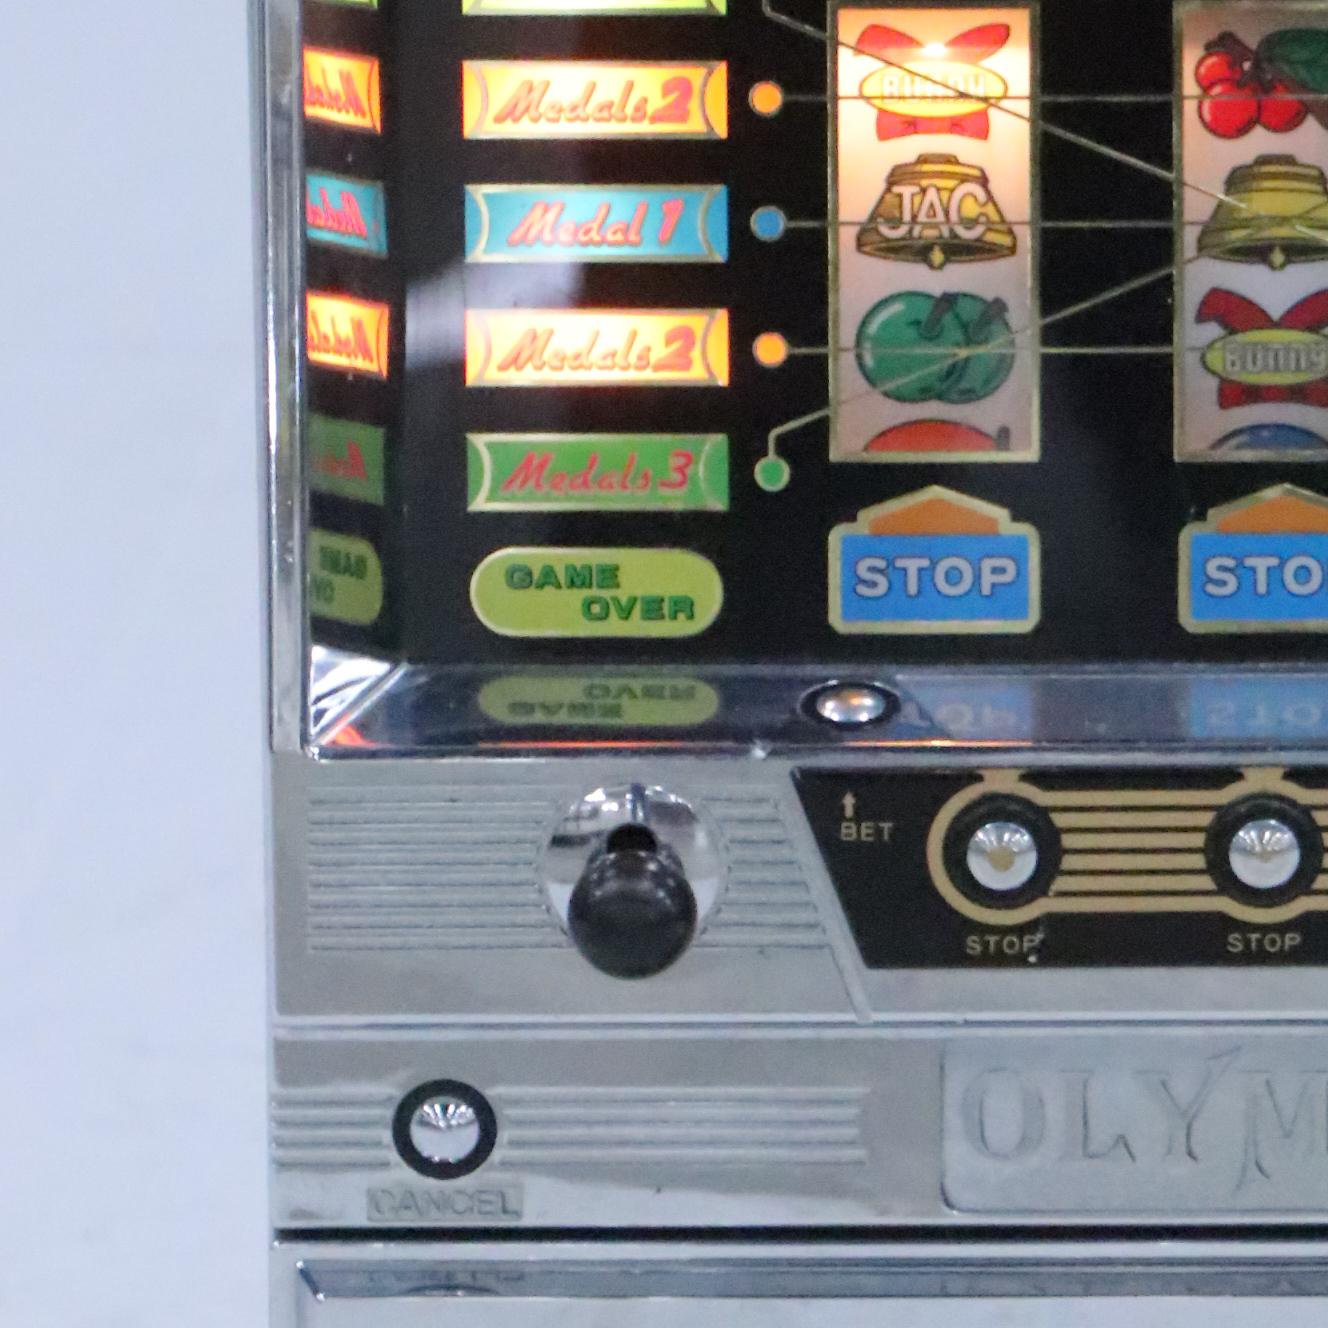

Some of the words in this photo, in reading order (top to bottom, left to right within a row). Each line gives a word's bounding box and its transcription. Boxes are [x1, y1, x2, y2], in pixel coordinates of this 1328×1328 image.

[492, 79, 649, 125] Medals
[648, 76, 695, 125] 2
[507, 201, 649, 246] Medal
[657, 198, 685, 245] 1
[876, 181, 992, 240] JAC
[496, 327, 652, 373] Medals
[650, 324, 697, 372] 2
[500, 451, 651, 495] Medals
[659, 450, 694, 492] 3
[504, 563, 621, 590] GAME
[853, 555, 1019, 599] STOP
[581, 595, 695, 621] OVER
[840, 822, 894, 842] BET
[966, 934, 1039, 955] STOP
[1226, 933, 1303, 954] STOP
[372, 1188, 521, 1217] CANCEL
